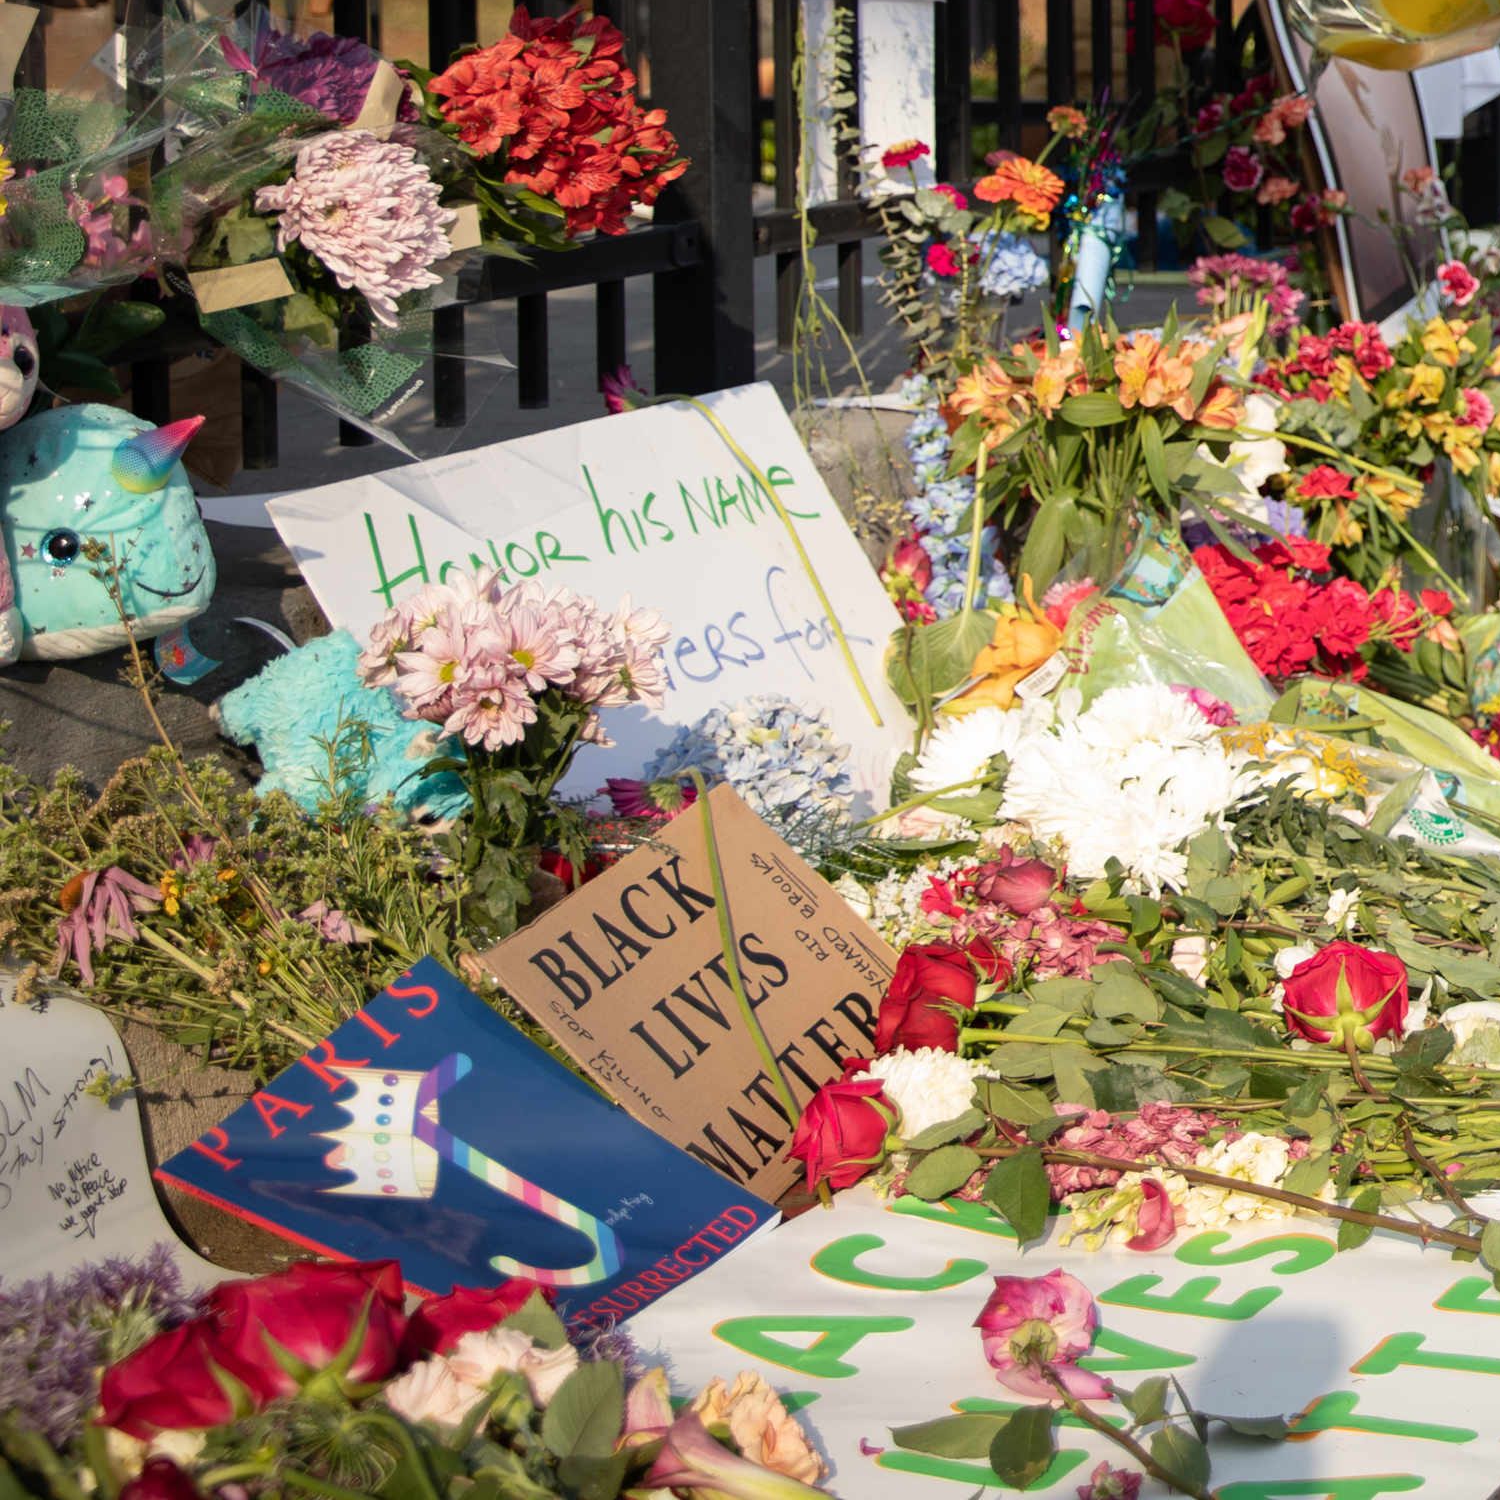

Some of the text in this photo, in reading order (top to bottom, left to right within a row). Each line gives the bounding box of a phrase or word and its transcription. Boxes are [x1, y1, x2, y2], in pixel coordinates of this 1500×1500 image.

[529, 854, 716, 1011] BLACK
[750, 852, 817, 919] BROOKS
[795, 929, 830, 962] RIP
[548, 1000, 673, 1123] STOP KILLING
[629, 932, 789, 1079] LIVES
[190, 971, 439, 1172] PARIS
[588, 1056, 614, 1085] US
[685, 991, 881, 1186] MATTER
[198, 1190, 243, 1214] Resurrected
[605, 1192, 654, 1226] ordyn King
[569, 1205, 757, 1337] ESURRECTED
